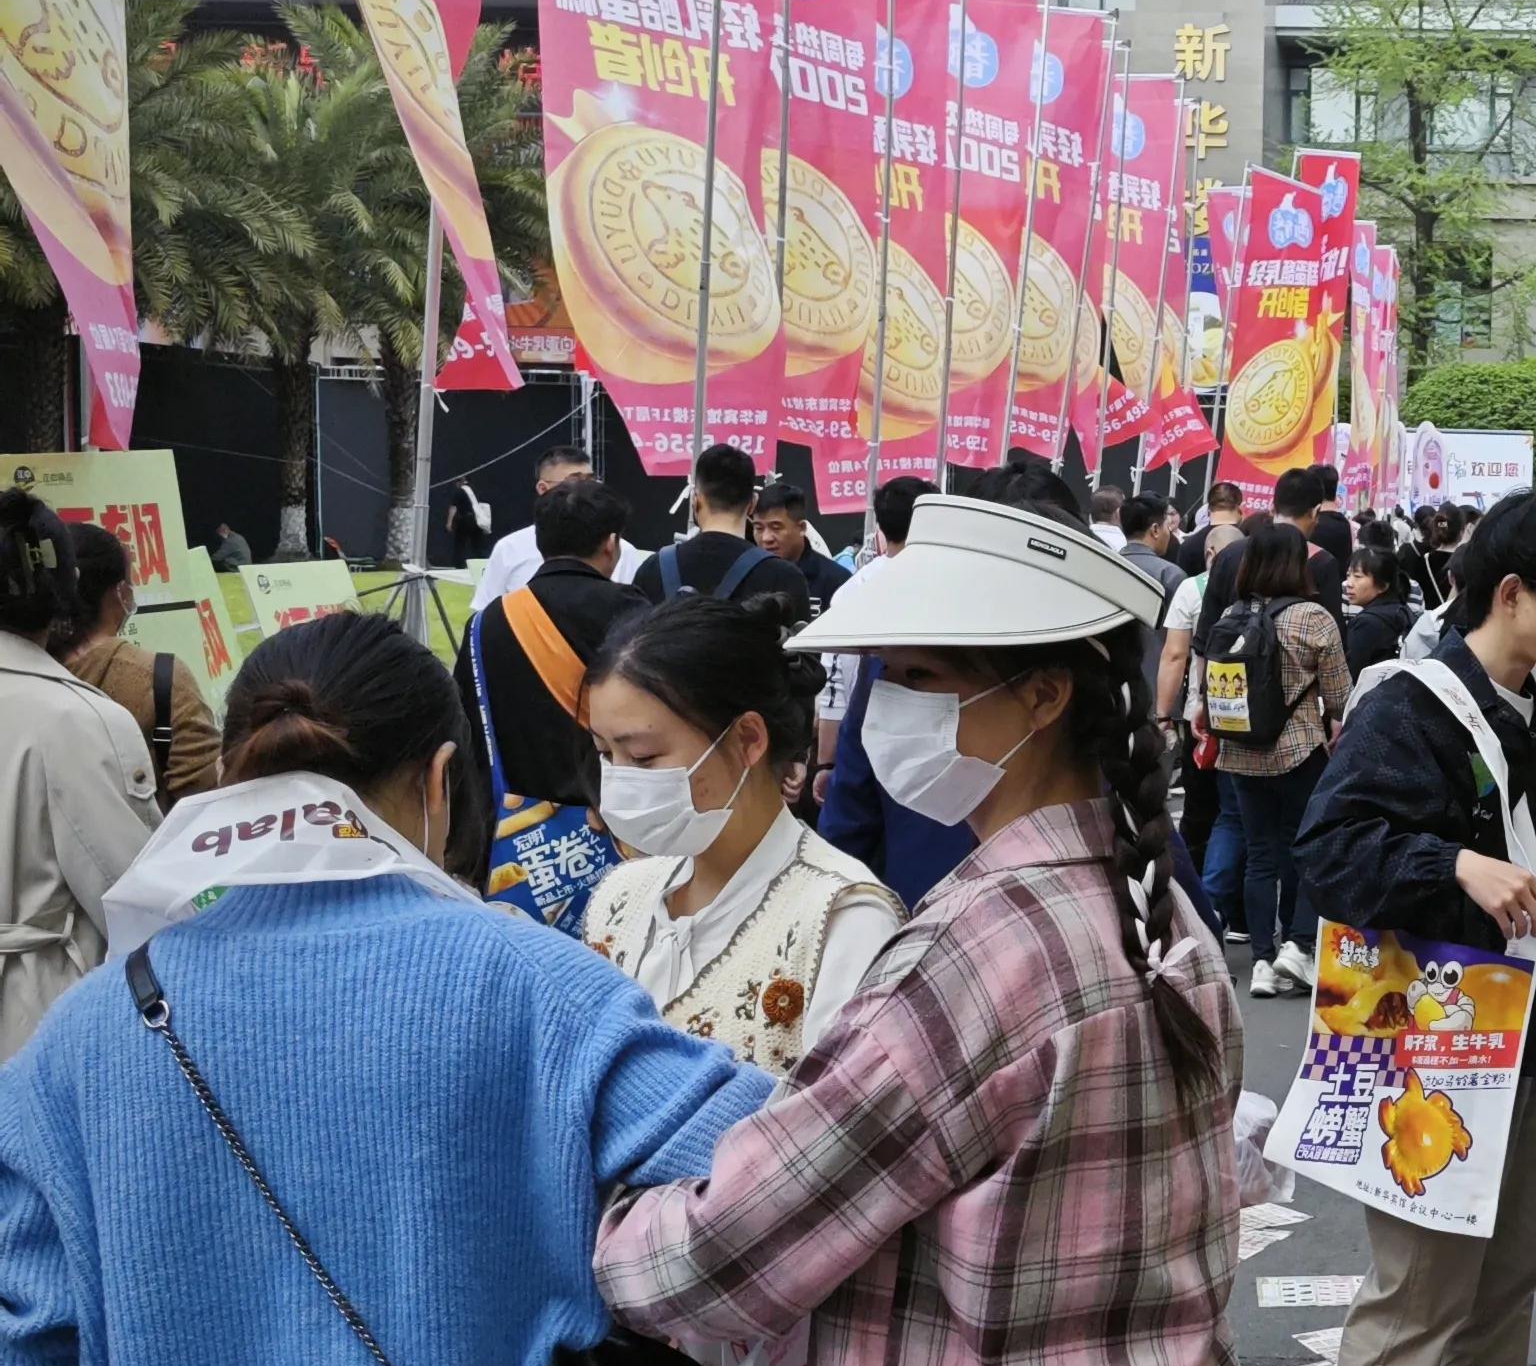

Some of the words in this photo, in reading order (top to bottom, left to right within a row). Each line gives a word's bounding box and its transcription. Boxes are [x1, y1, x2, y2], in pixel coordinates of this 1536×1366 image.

[518, 838, 597, 893] 蛋卷
[1318, 1062, 1379, 1104] 土豆
[1302, 1105, 1370, 1148] 螃蟹
